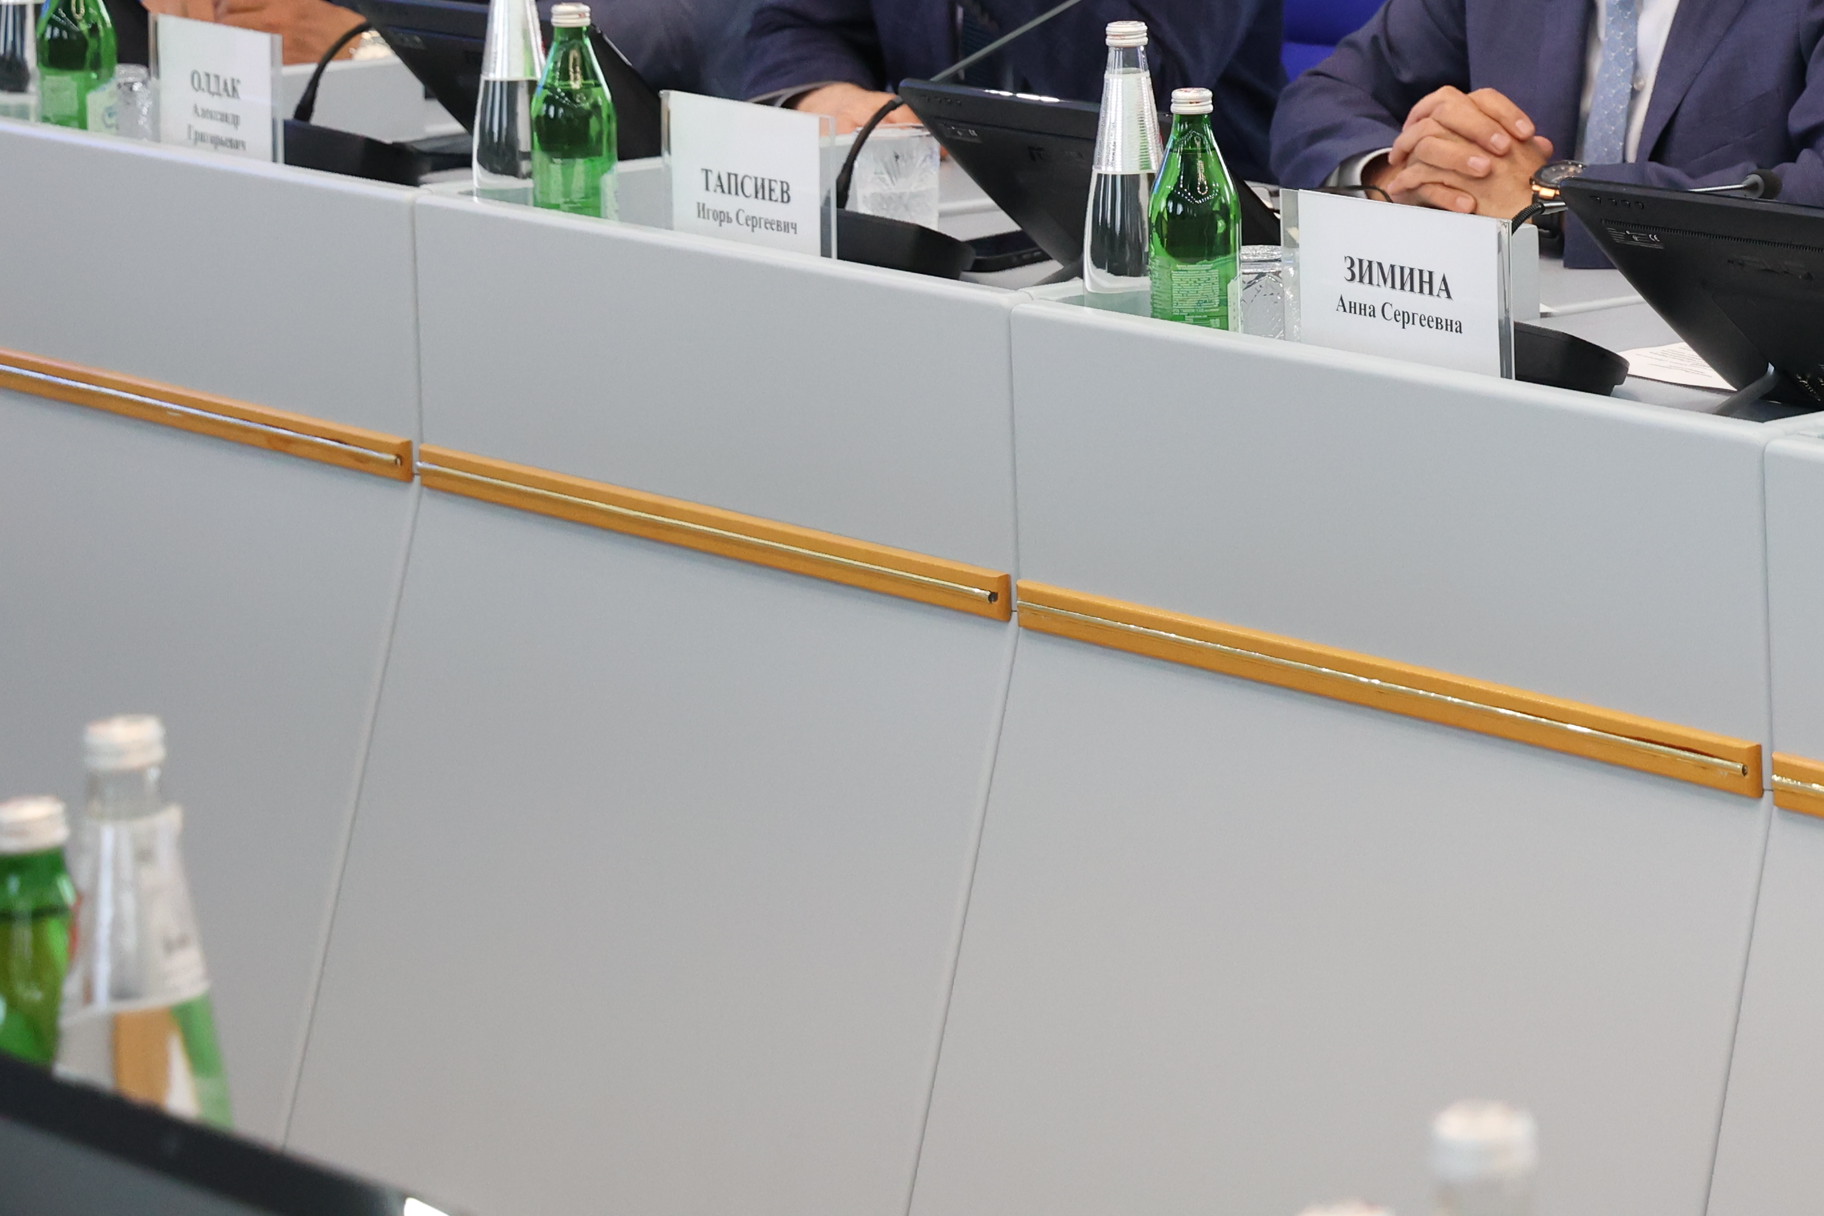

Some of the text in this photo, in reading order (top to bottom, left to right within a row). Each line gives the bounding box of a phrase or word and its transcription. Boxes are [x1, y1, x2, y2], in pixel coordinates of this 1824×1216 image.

[190, 69, 242, 100] ОЛДАК
[701, 167, 792, 205] ТАПСИЕВ
[696, 201, 798, 235] Игорь Сергеевич
[1343, 255, 1454, 301] ЗИМИНА
[1336, 294, 1464, 335] Анна Сергеевна
